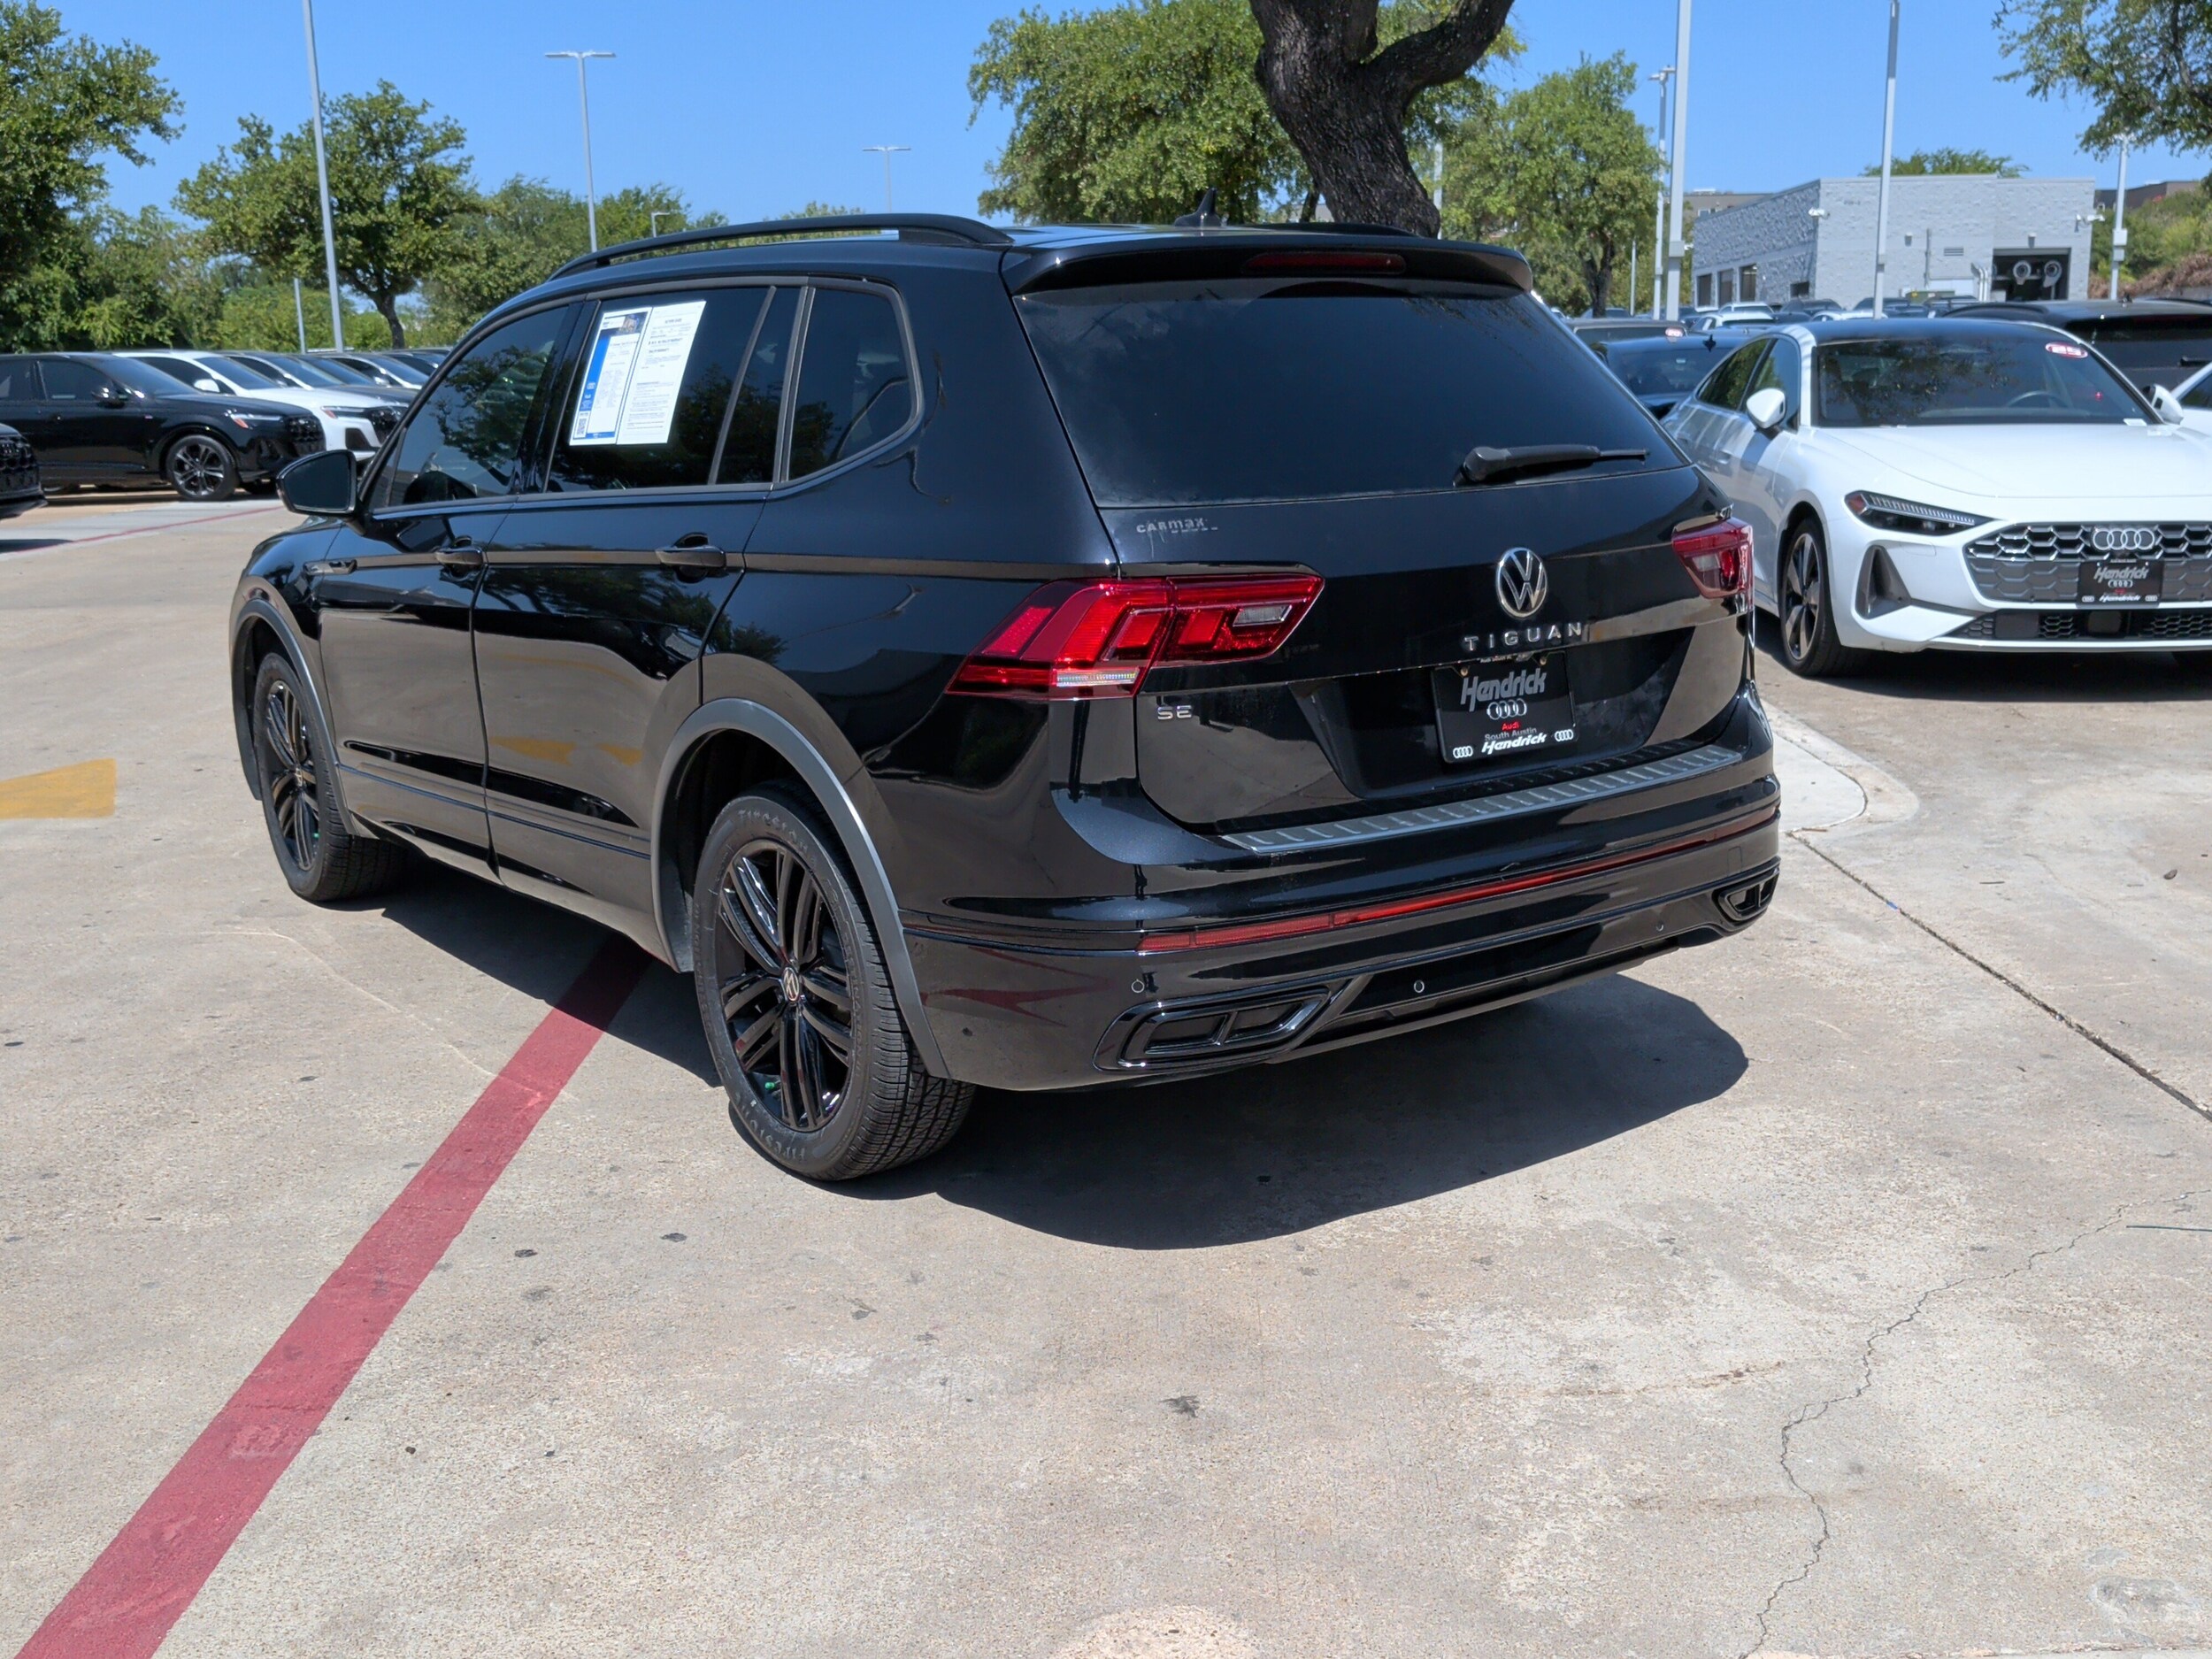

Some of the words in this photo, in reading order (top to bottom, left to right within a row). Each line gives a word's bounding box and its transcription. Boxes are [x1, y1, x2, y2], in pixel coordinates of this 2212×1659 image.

[2093, 566, 2149, 584] Hendrick
[1463, 621, 1582, 651] TIGUAN
[1460, 667, 1548, 712] Hendrick
[1157, 704, 1192, 720] SE
[1484, 731, 1509, 741] South
[1511, 727, 1538, 736] Austin
[1502, 721, 1520, 731] Audi
[1481, 733, 1548, 755] Hendrick
